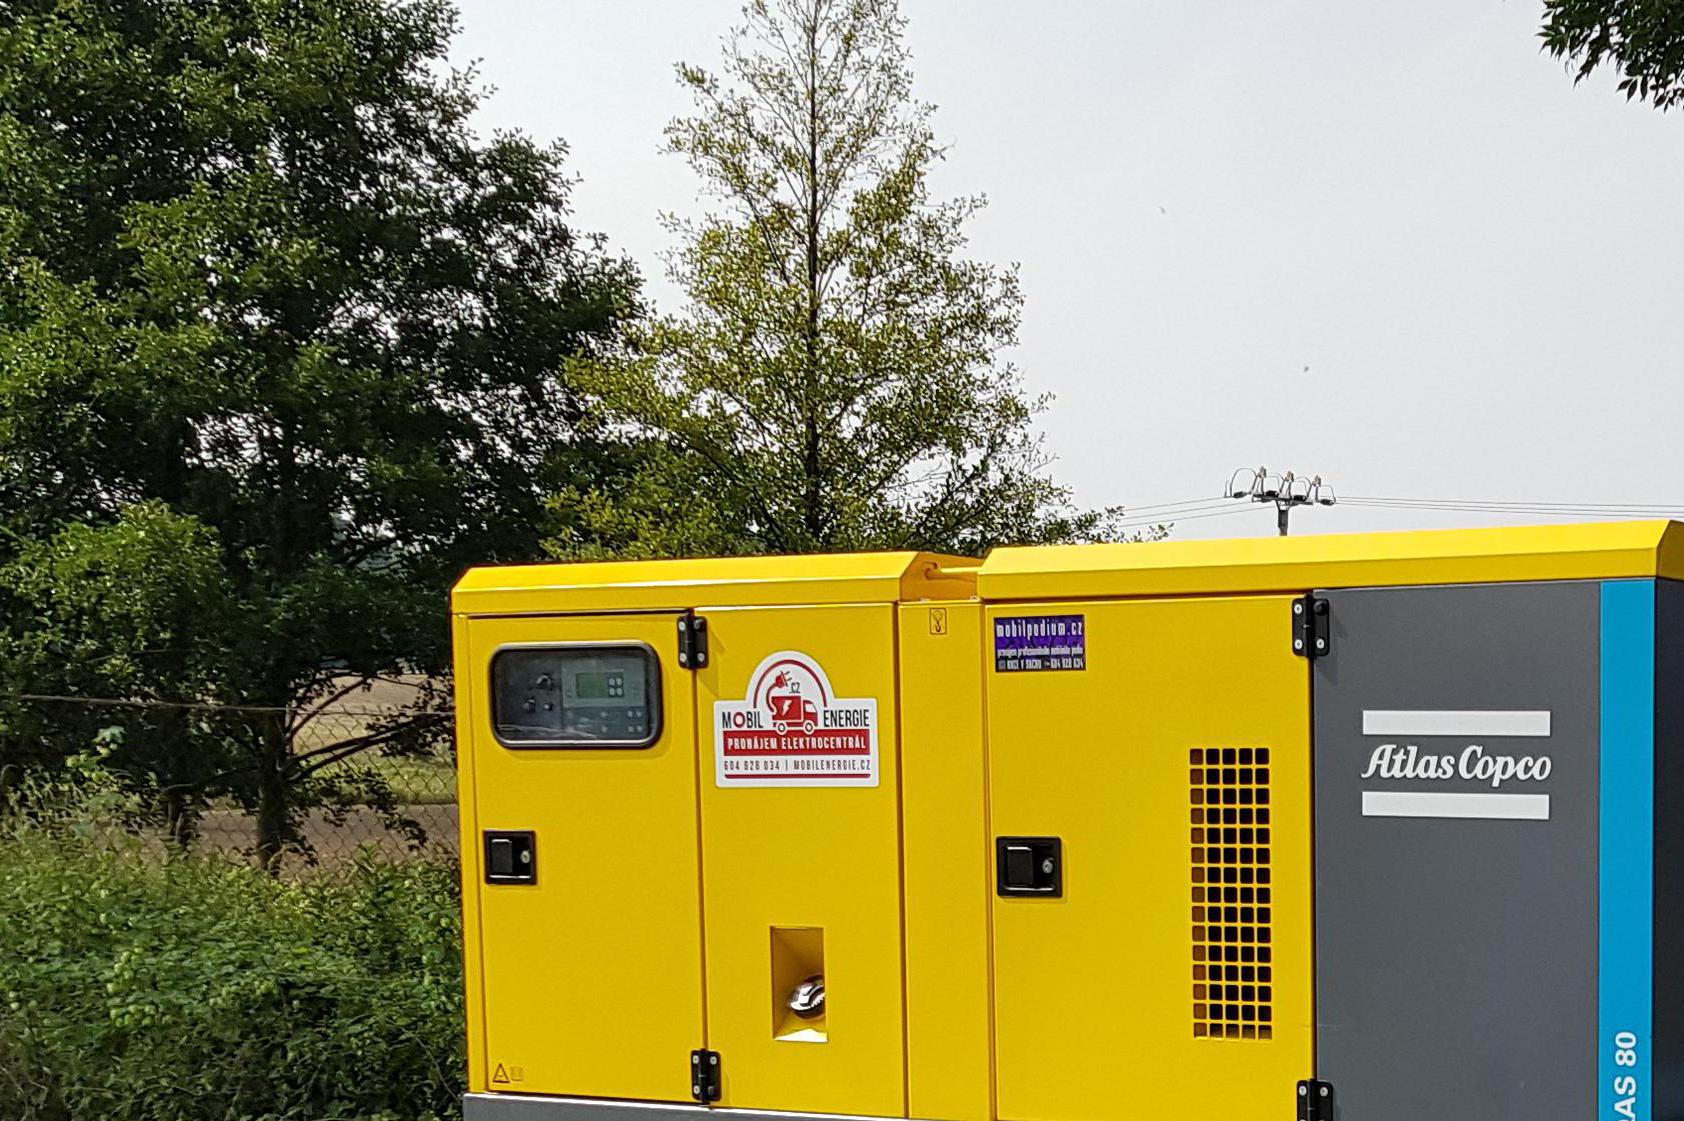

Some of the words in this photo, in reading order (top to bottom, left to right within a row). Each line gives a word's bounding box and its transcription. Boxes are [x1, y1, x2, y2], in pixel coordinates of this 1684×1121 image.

[996, 619, 1083, 641] mobilpodium.cz
[722, 711, 764, 729] MOBIL
[823, 709, 870, 727] ENERGIE
[727, 736, 778, 750] PRONÁJEM
[781, 735, 866, 749] ELEKTROCENTRÁL
[793, 759, 871, 771] MOBILENERGIE.CZ
[1360, 744, 1455, 780] Atlas
[1457, 745, 1552, 788] Copco
[1615, 1031, 1637, 1067] 80
